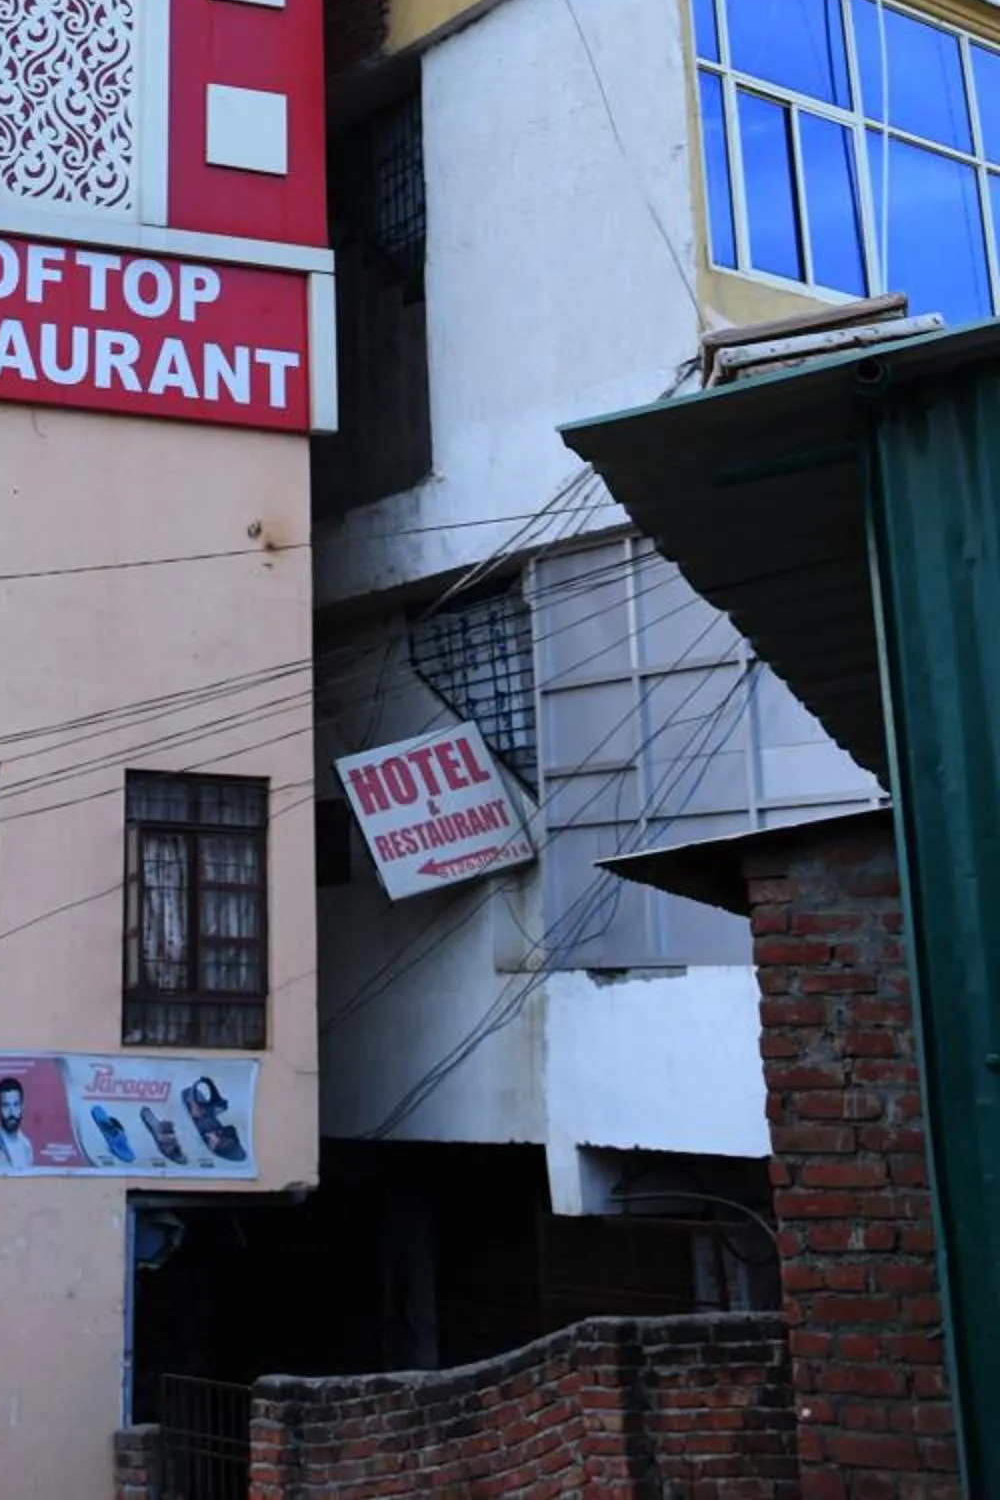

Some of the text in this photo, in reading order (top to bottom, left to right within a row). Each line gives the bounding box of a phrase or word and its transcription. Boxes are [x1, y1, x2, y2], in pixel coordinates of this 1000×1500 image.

[348, 737, 491, 816] HOTEL
[374, 798, 511, 863] RESTAURANT
[83, 1062, 172, 1097] Paragon
